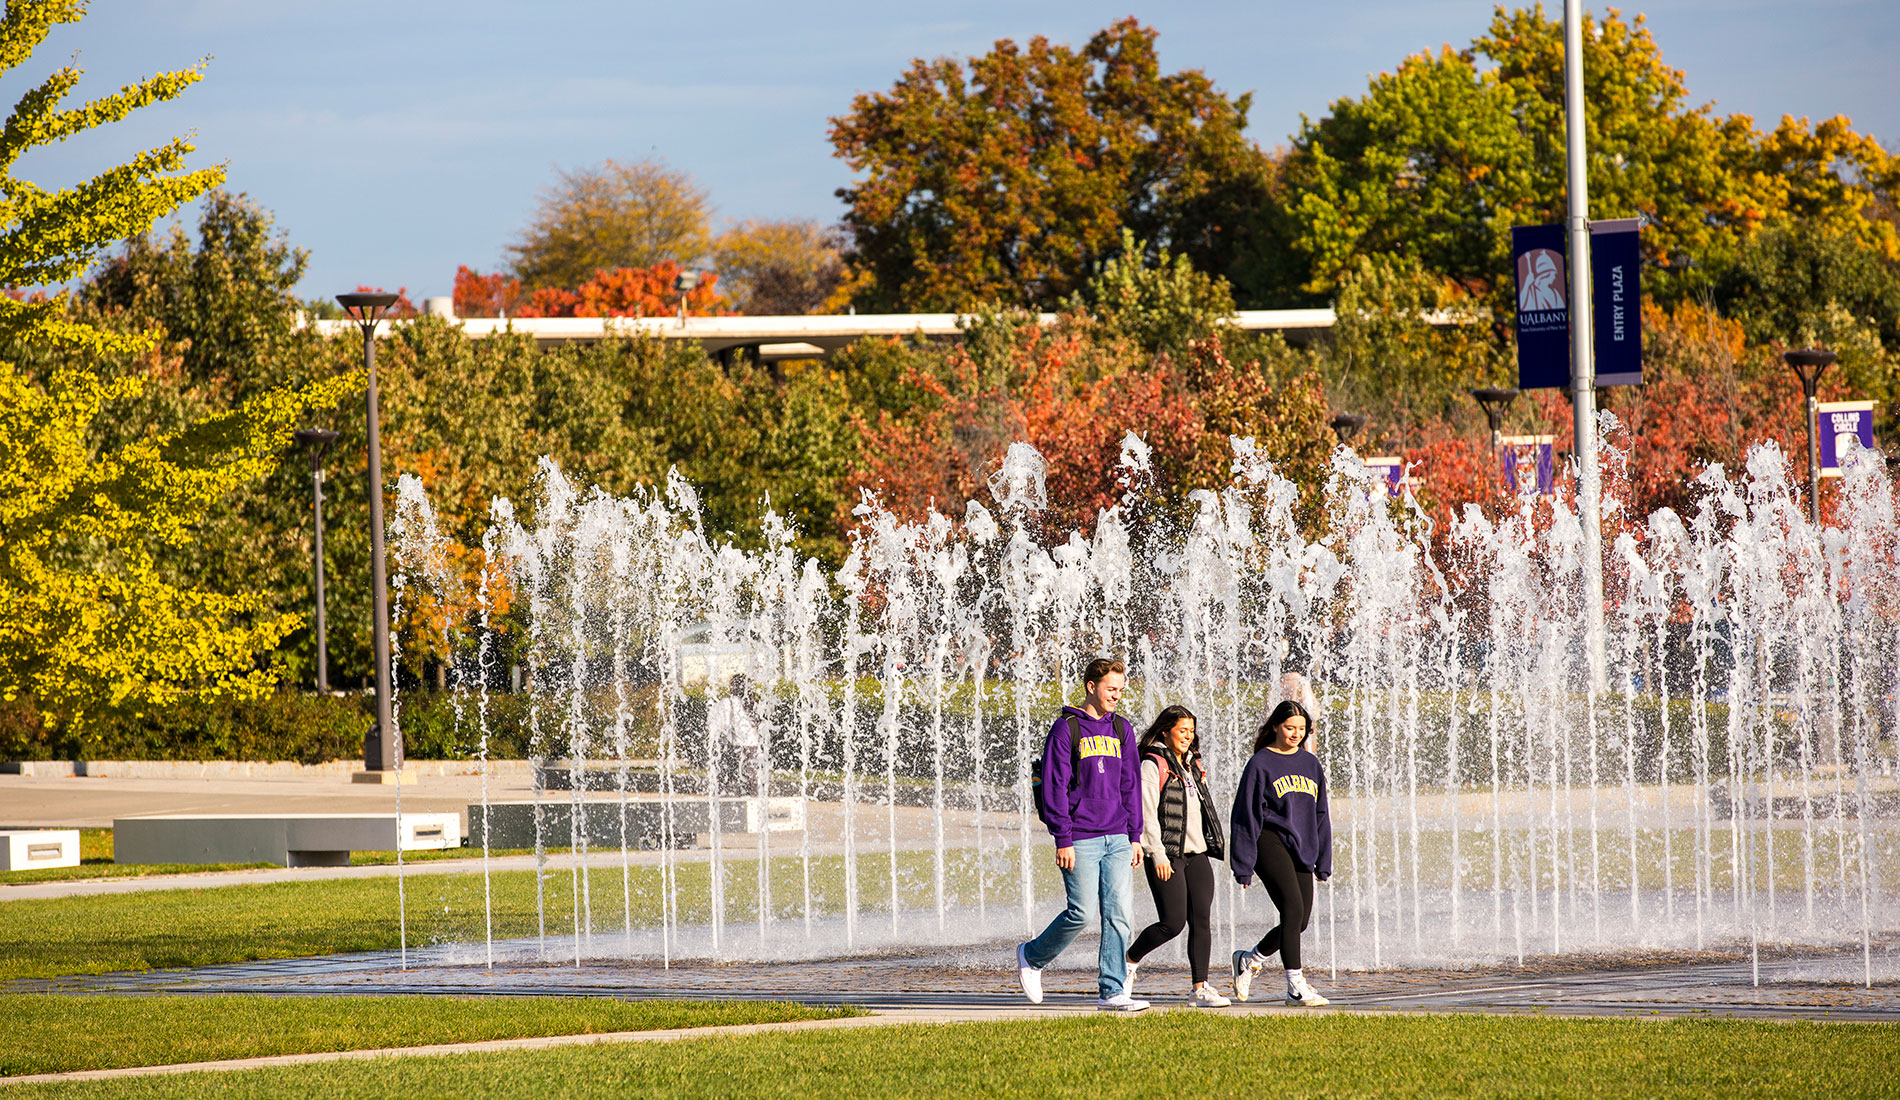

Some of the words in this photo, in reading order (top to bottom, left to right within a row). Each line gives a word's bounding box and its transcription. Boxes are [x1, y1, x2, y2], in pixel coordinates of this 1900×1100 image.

[1612, 265, 1624, 302] PLAZA
[1520, 311, 1567, 326] UALBANY
[1613, 305, 1625, 341] ENTRY
[1831, 412, 1860, 424] COLLINS
[1834, 423, 1858, 433] CIRCLE
